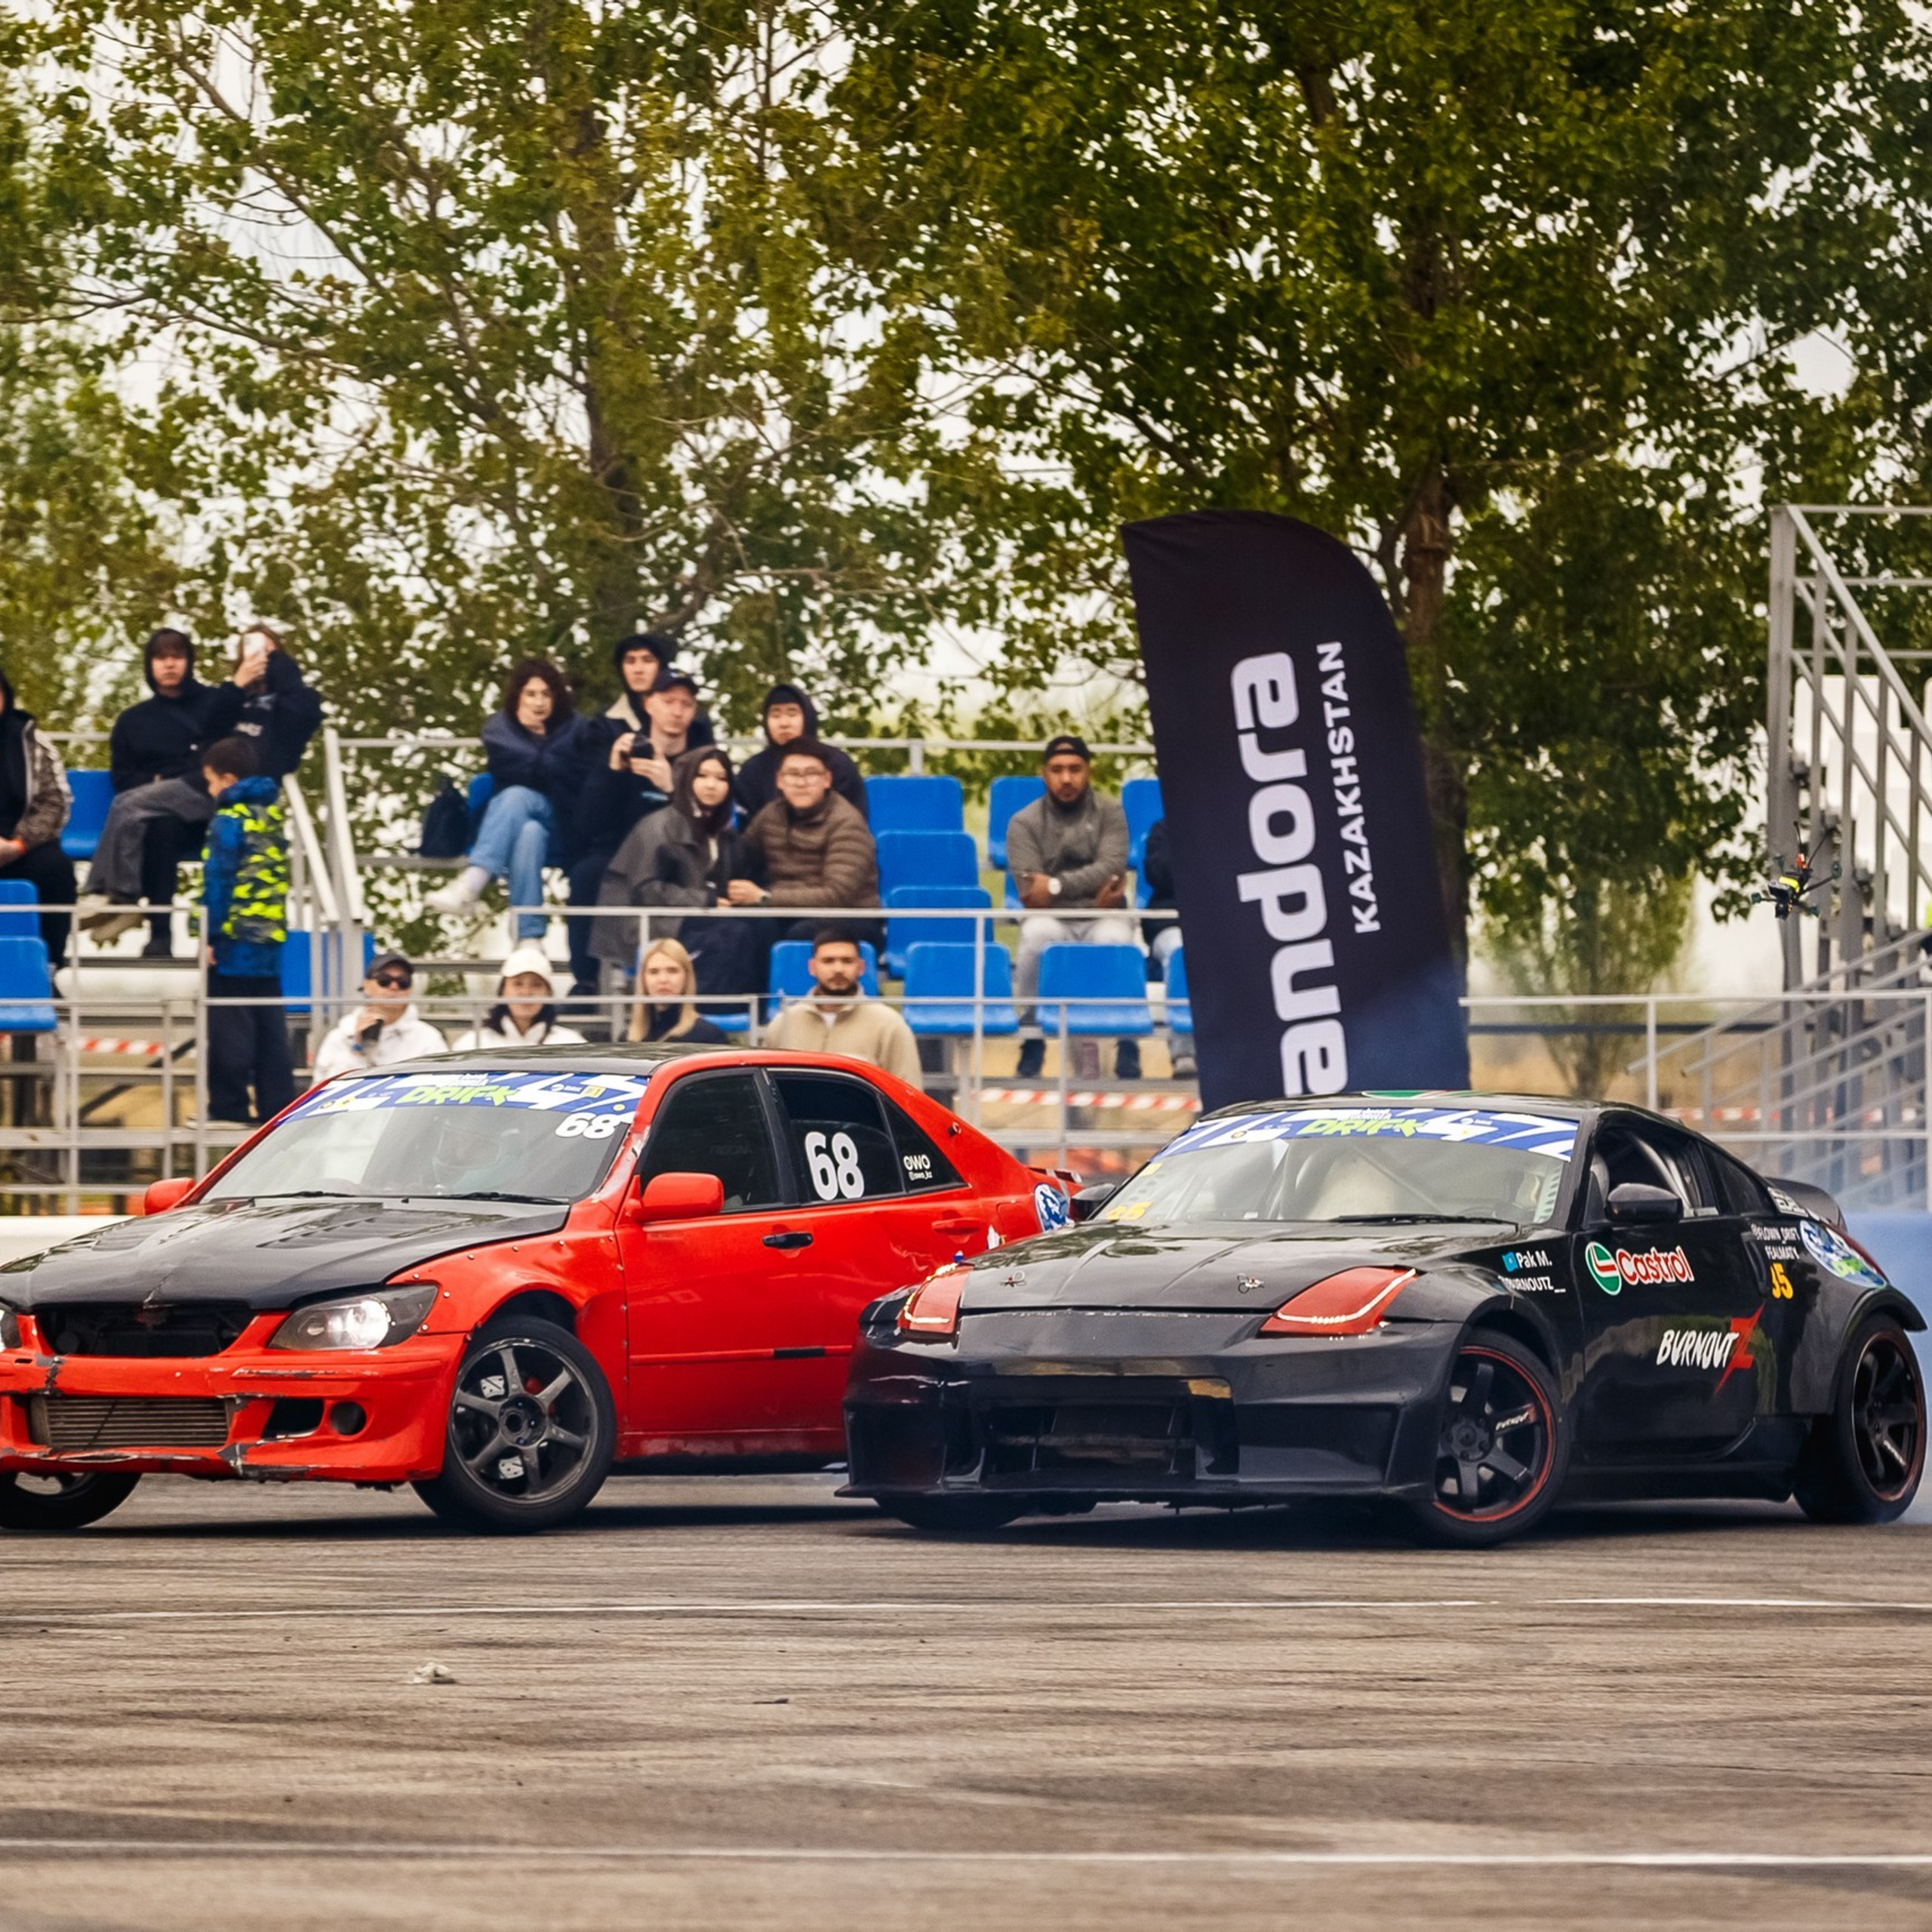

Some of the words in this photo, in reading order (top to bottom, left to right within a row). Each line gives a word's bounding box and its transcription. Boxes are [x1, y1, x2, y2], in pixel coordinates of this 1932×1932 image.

[1316, 641, 1380, 933] KAZAKHSTAN
[555, 1112, 620, 1139] 68
[804, 1131, 865, 1201] 68
[1515, 1251, 1537, 1268] Pak
[1535, 1250, 1552, 1267] M.
[1616, 1245, 1694, 1285] Castrol
